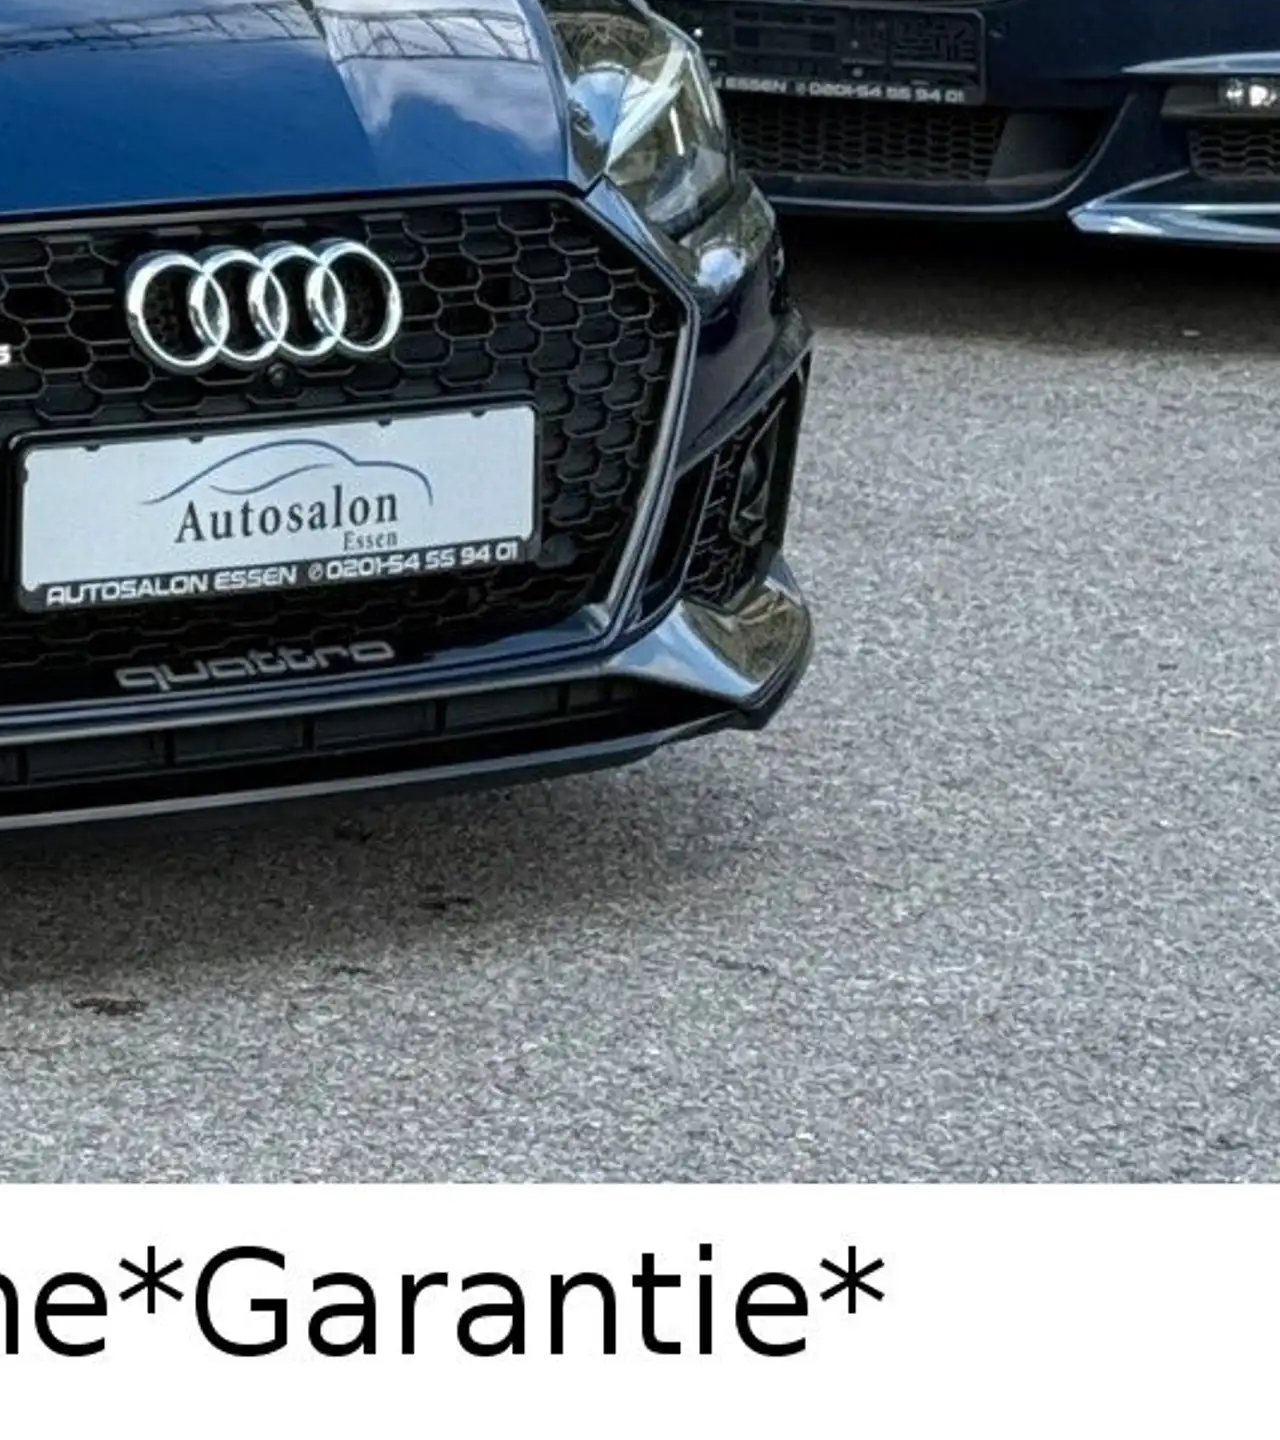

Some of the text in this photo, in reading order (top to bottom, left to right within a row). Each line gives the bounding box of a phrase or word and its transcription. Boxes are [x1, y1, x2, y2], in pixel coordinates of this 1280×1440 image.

[174, 484, 399, 543] Autosalon
[343, 530, 398, 551] Essen
[46, 541, 519, 607] AUTOSALON ESSEN 0201-54 55 94 01
[114, 640, 395, 691] quattro
